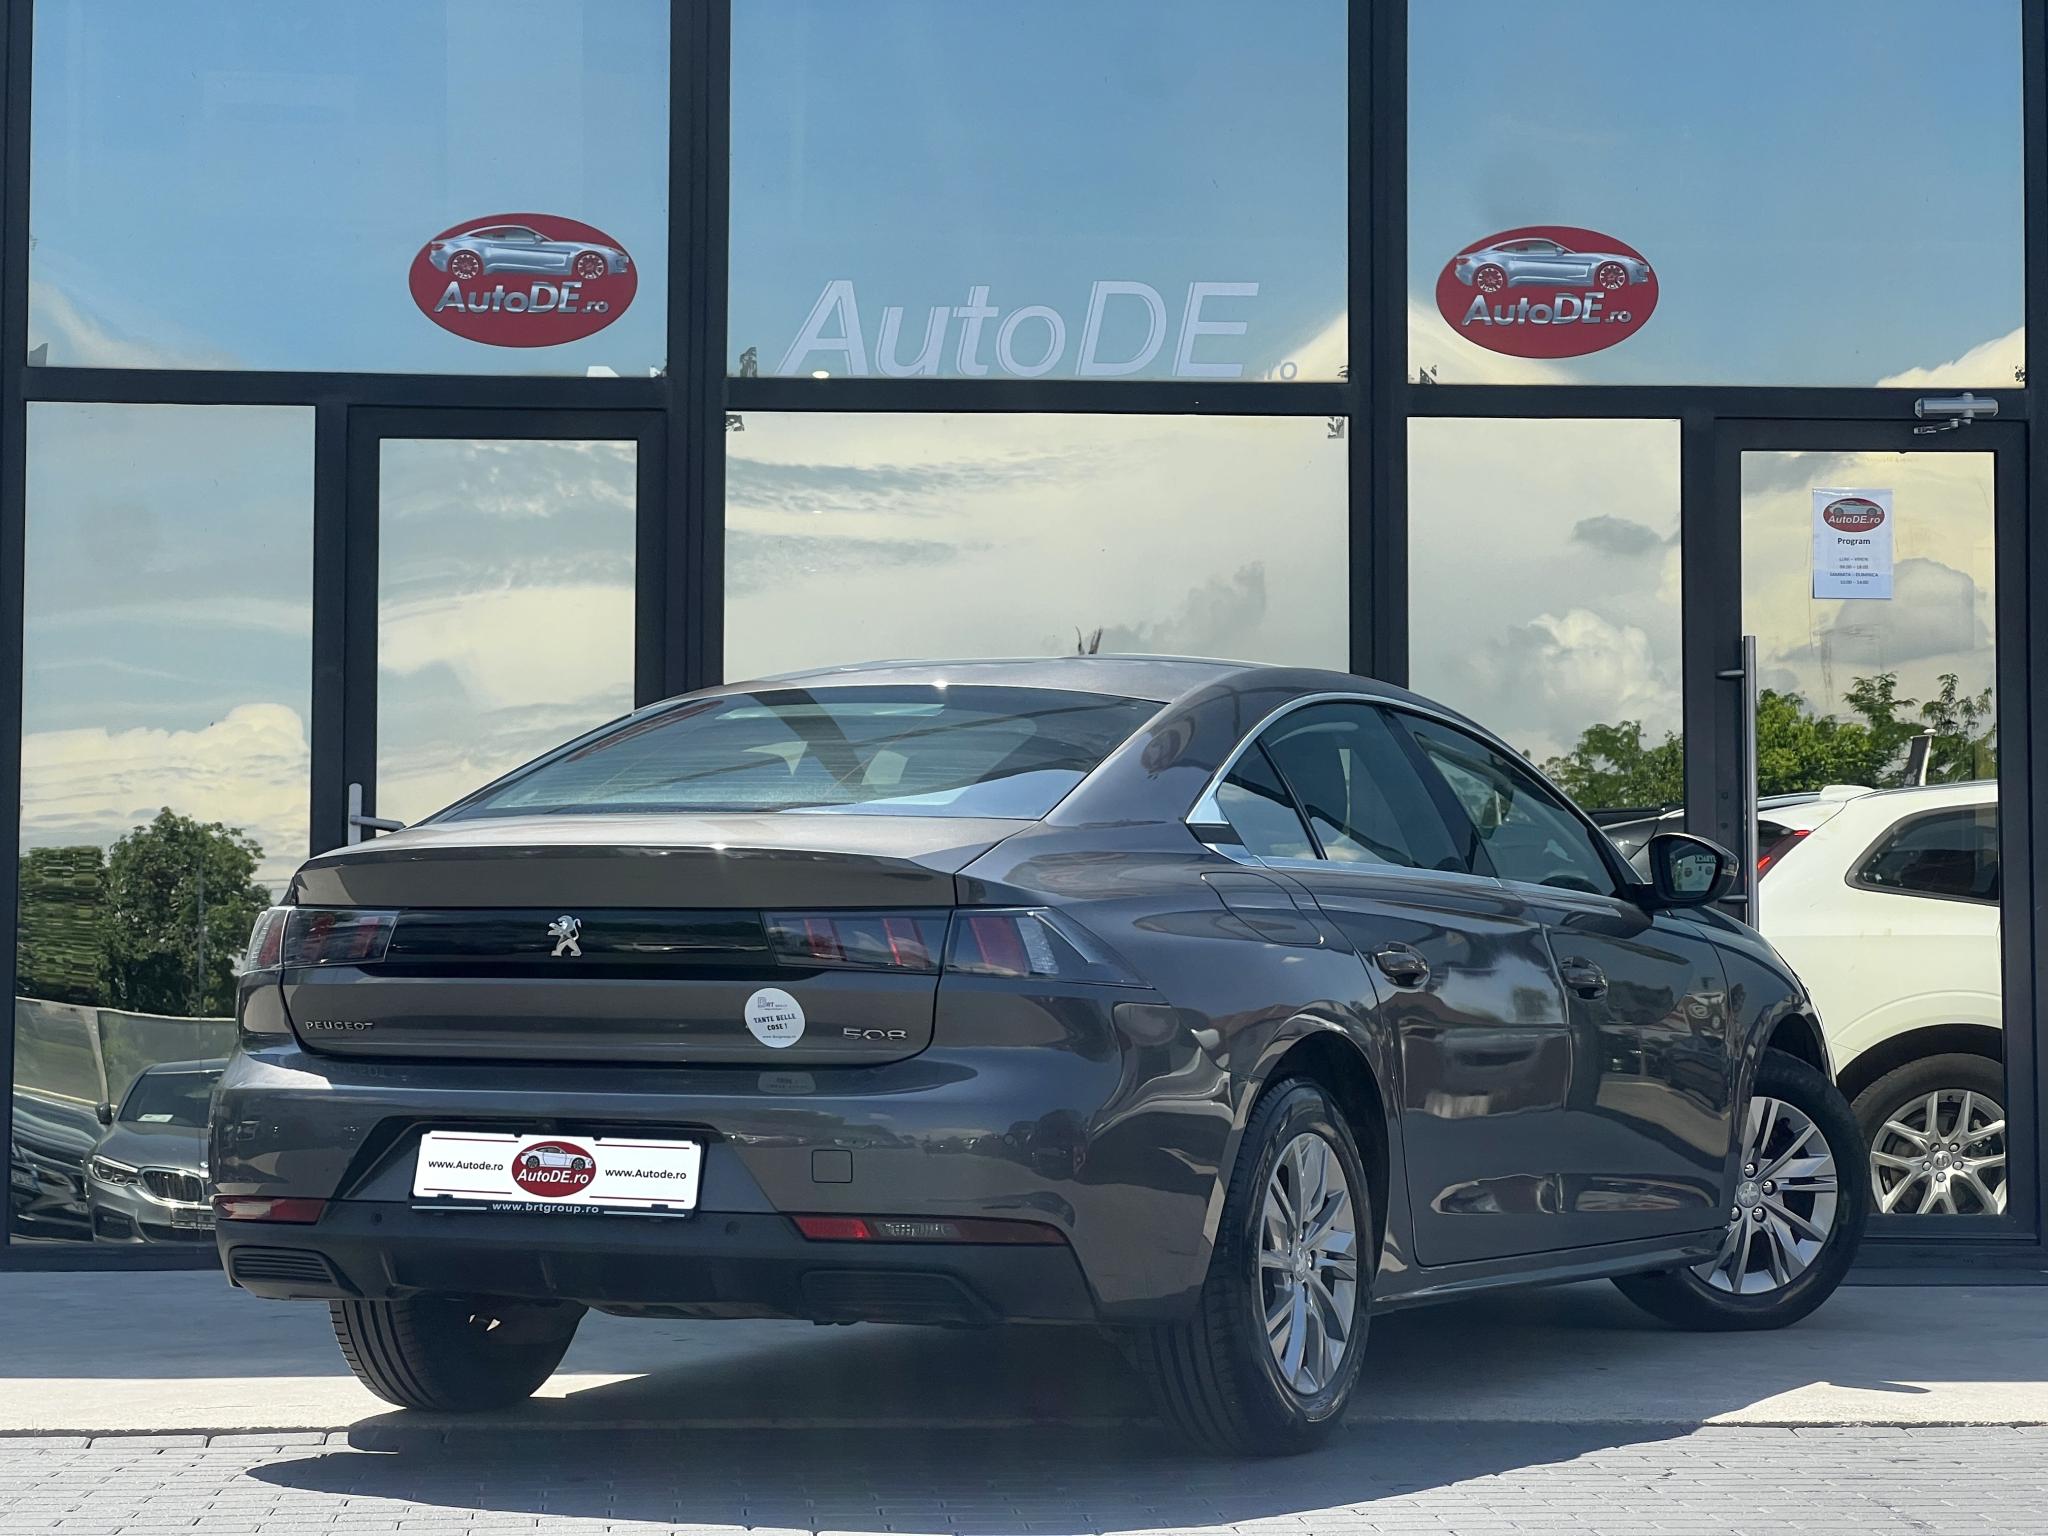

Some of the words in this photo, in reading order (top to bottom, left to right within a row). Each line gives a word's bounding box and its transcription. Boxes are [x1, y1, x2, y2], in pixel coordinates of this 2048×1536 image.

[1837, 537, 1871, 546] Program
[753, 1015, 775, 1024] TANTE
[776, 1013, 797, 1022] BELLE
[767, 1023, 784, 1031] COSE
[843, 1027, 907, 1041] 508
[428, 1159, 504, 1171] www.Autode.ro
[516, 1168, 589, 1185] AutoDE.ro
[604, 1168, 687, 1180] www.Autode.ro
[492, 1202, 600, 1215] www.brtgroup.ro
